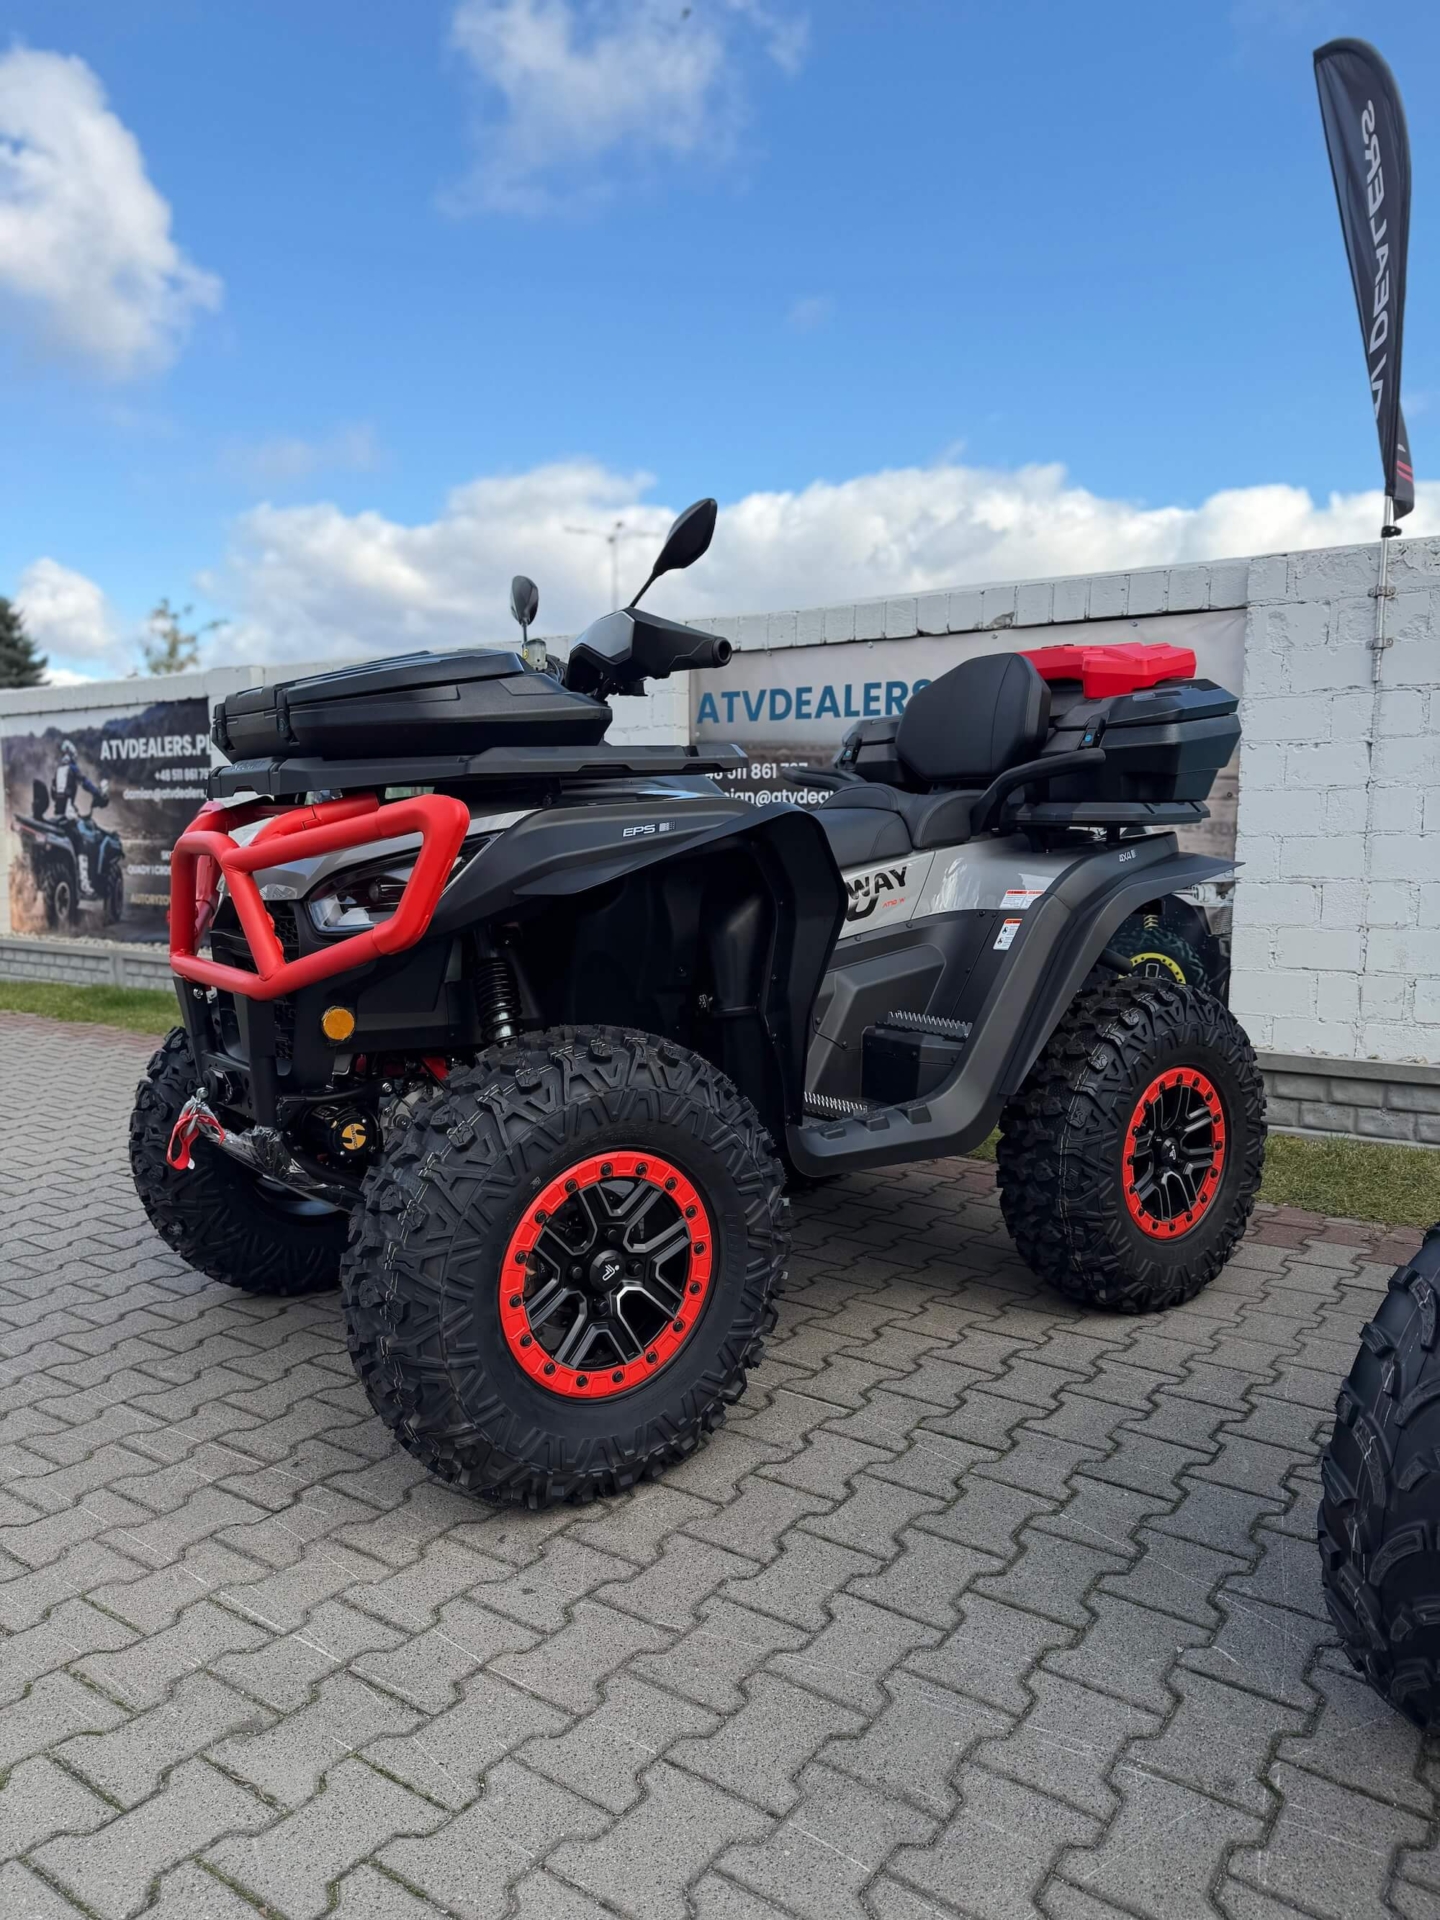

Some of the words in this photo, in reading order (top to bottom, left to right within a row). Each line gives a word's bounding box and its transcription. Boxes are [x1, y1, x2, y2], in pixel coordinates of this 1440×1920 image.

[751, 763, 777, 780] 861
[623, 824, 656, 838] EPS
[846, 866, 907, 912] WAY
